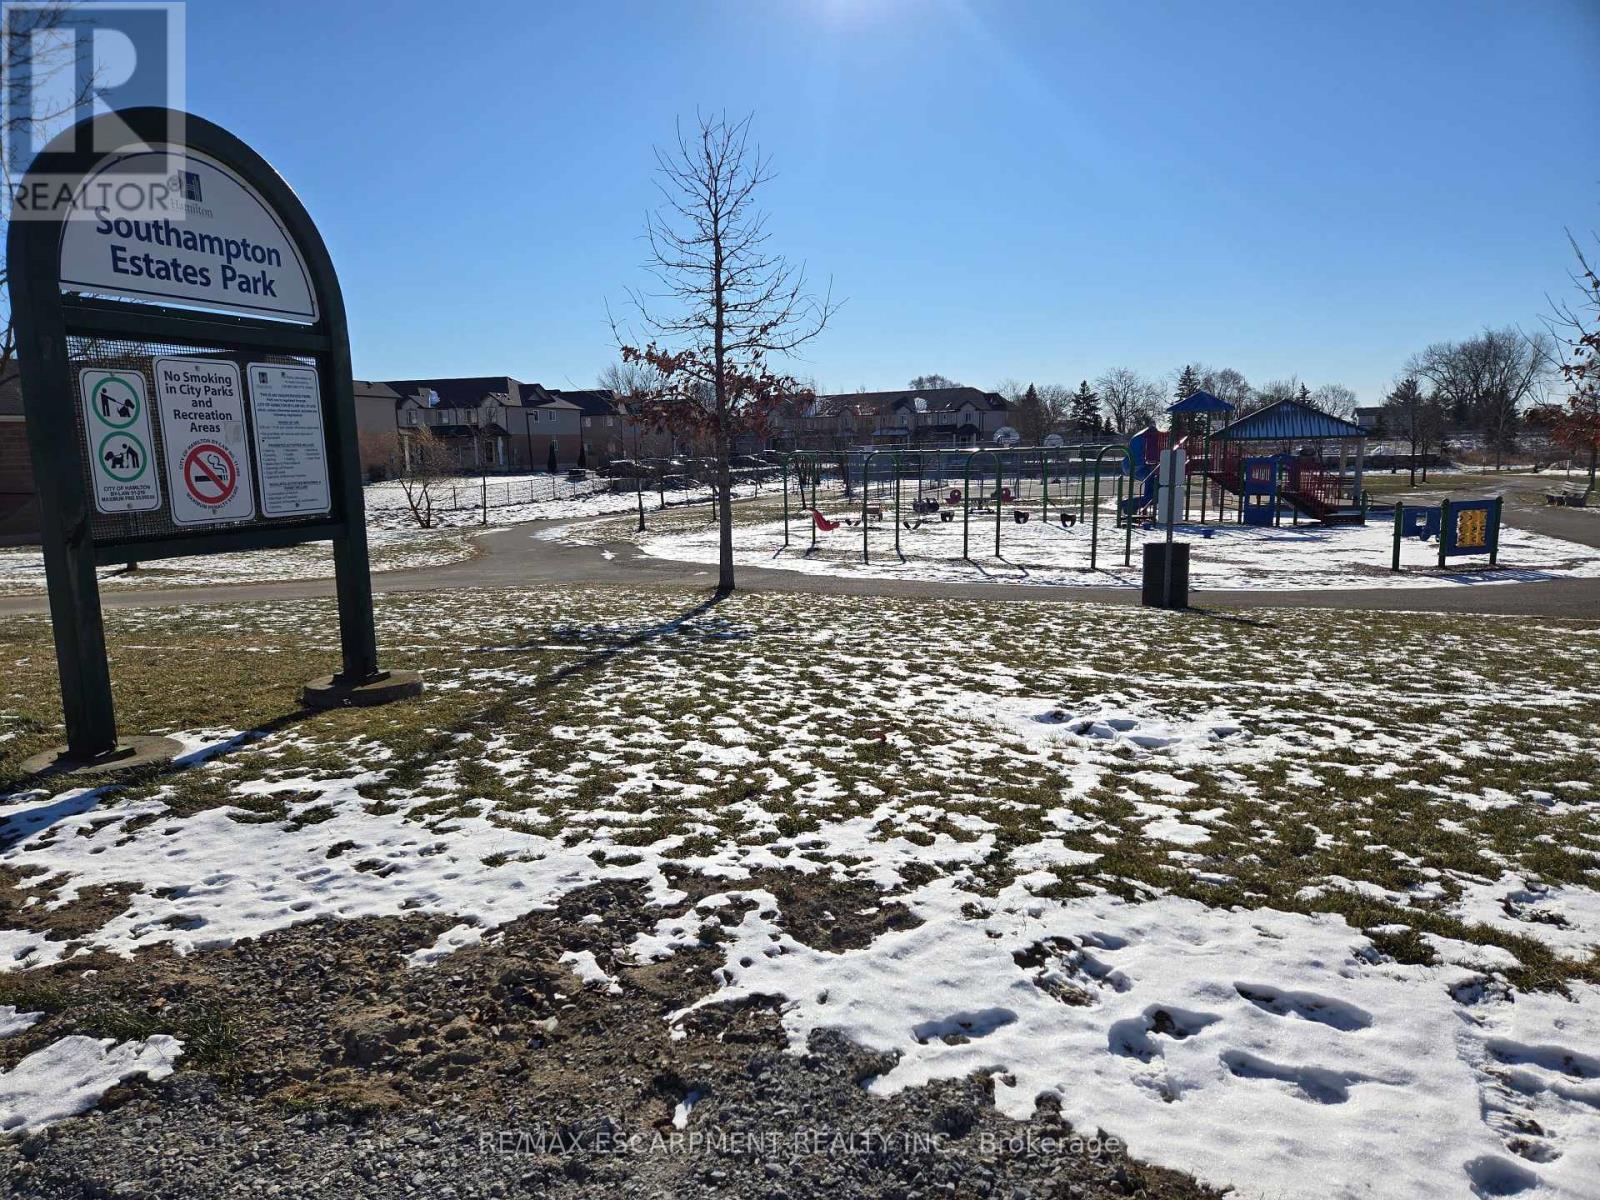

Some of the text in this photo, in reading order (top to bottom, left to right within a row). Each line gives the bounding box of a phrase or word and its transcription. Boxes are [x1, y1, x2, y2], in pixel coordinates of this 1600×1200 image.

[95, 206, 281, 267] Southampton
[110, 244, 277, 297] Estates Park
[164, 370, 232, 387] No Smoking
[165, 383, 234, 398] in City Parks
[191, 397, 213, 408] and
[173, 409, 233, 420] Recreation
[190, 422, 221, 432] Areas
